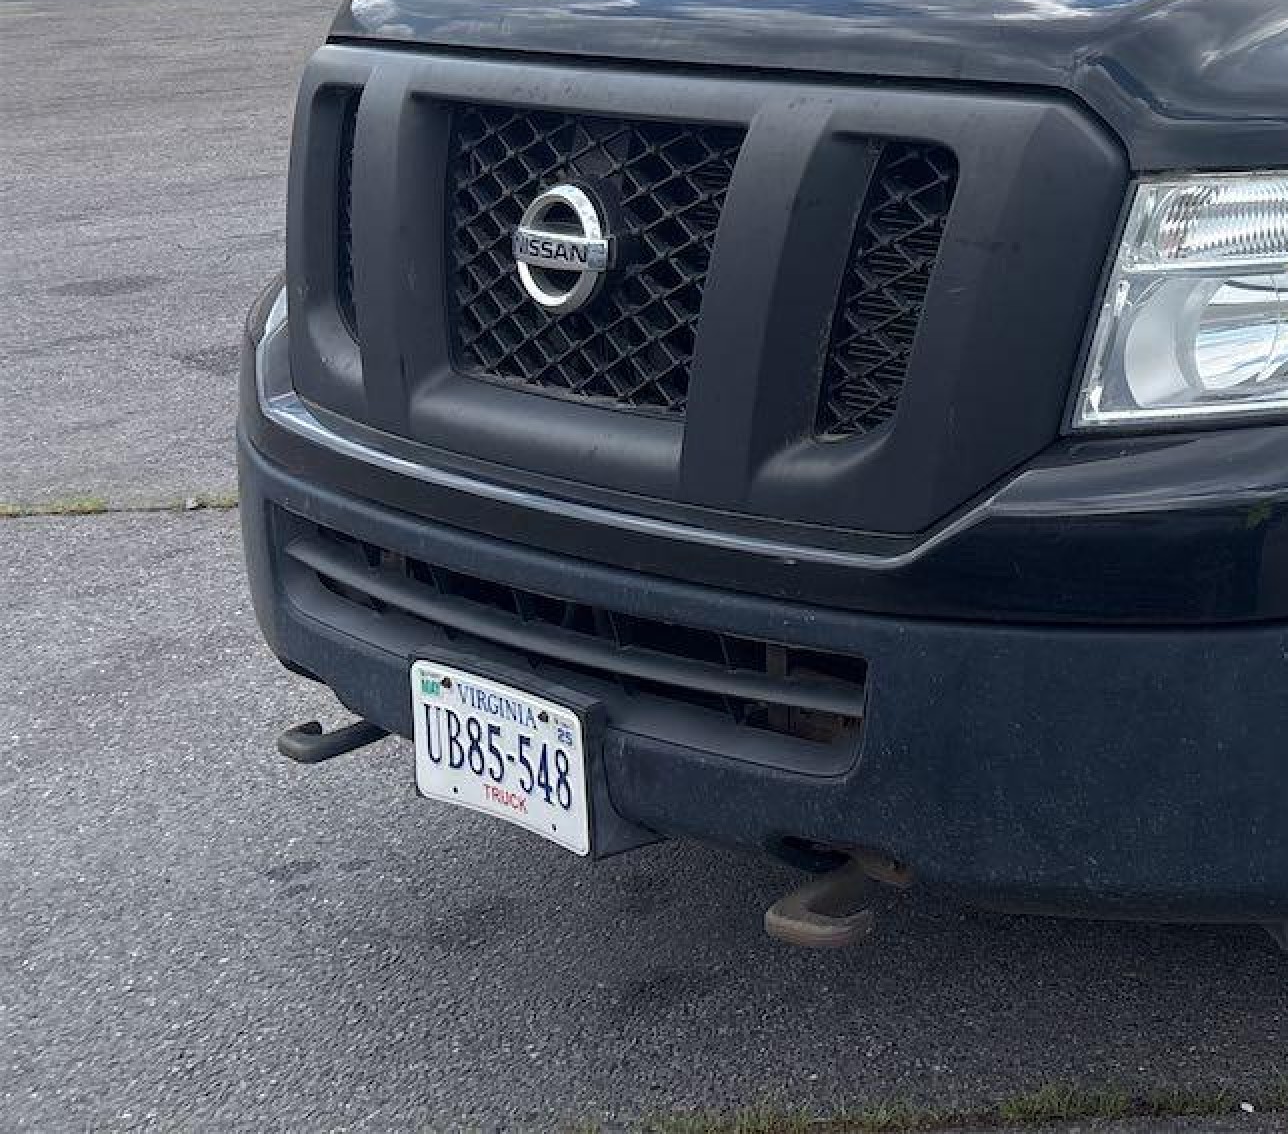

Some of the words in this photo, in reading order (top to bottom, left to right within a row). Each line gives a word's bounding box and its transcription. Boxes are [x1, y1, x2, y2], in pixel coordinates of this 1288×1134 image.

[515, 234, 588, 263] NISSAN
[457, 683, 537, 729] VIRGINIA
[424, 704, 572, 810] UB85-548
[483, 784, 528, 814] TRUCK
